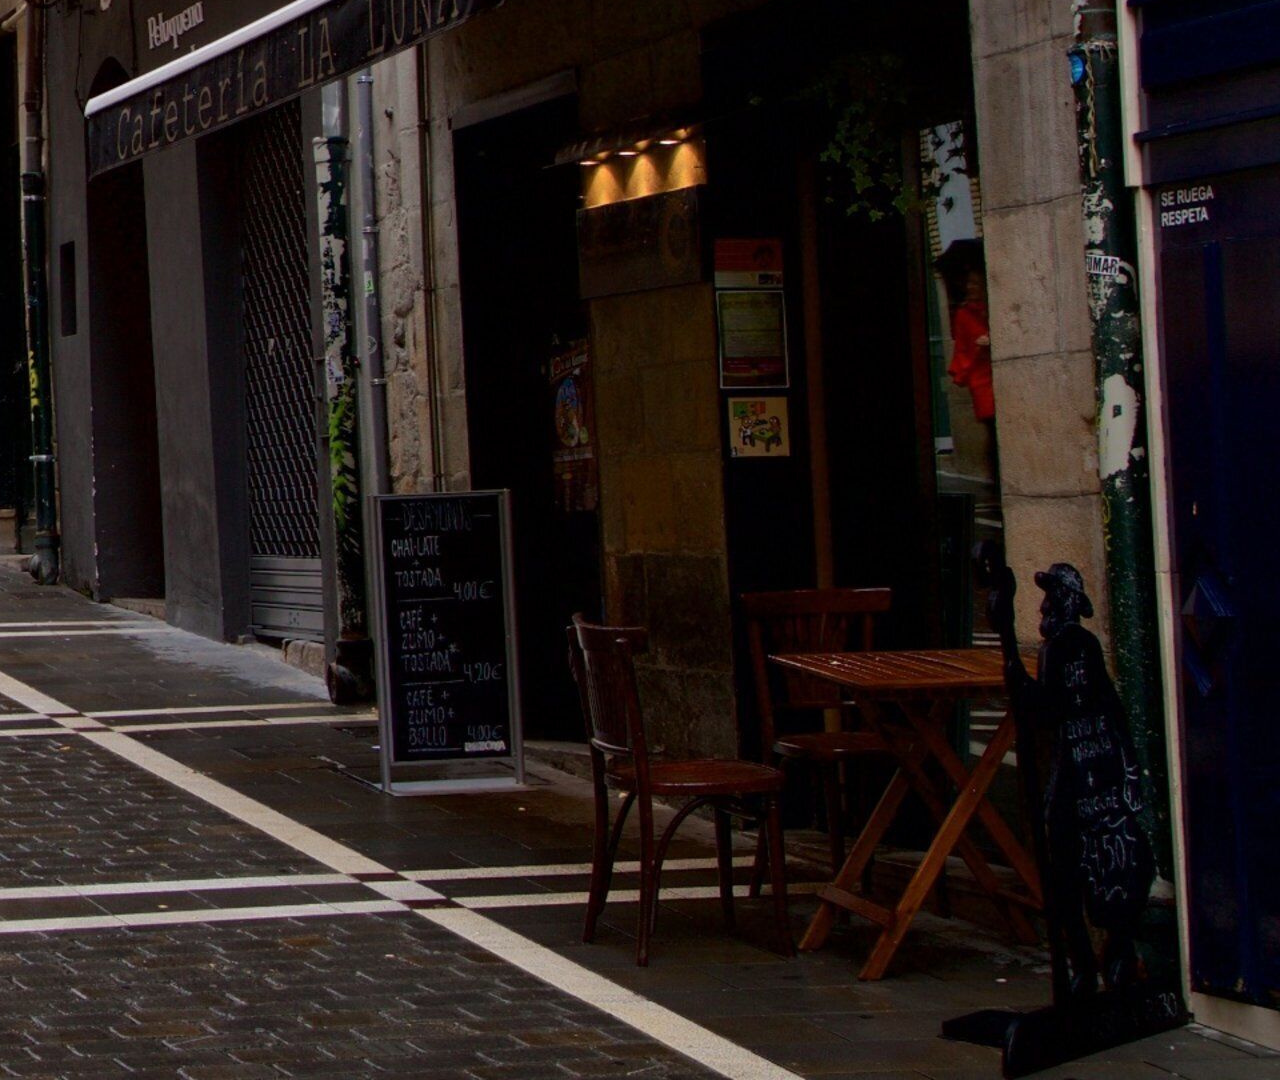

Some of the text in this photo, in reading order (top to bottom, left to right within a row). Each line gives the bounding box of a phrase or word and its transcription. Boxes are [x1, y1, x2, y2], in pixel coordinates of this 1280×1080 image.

[116, 49, 269, 162] Cafetería
[297, 17, 337, 89] LA
[1161, 185, 1214, 207] SE RUEGA
[1161, 207, 1209, 227] RESPETA
